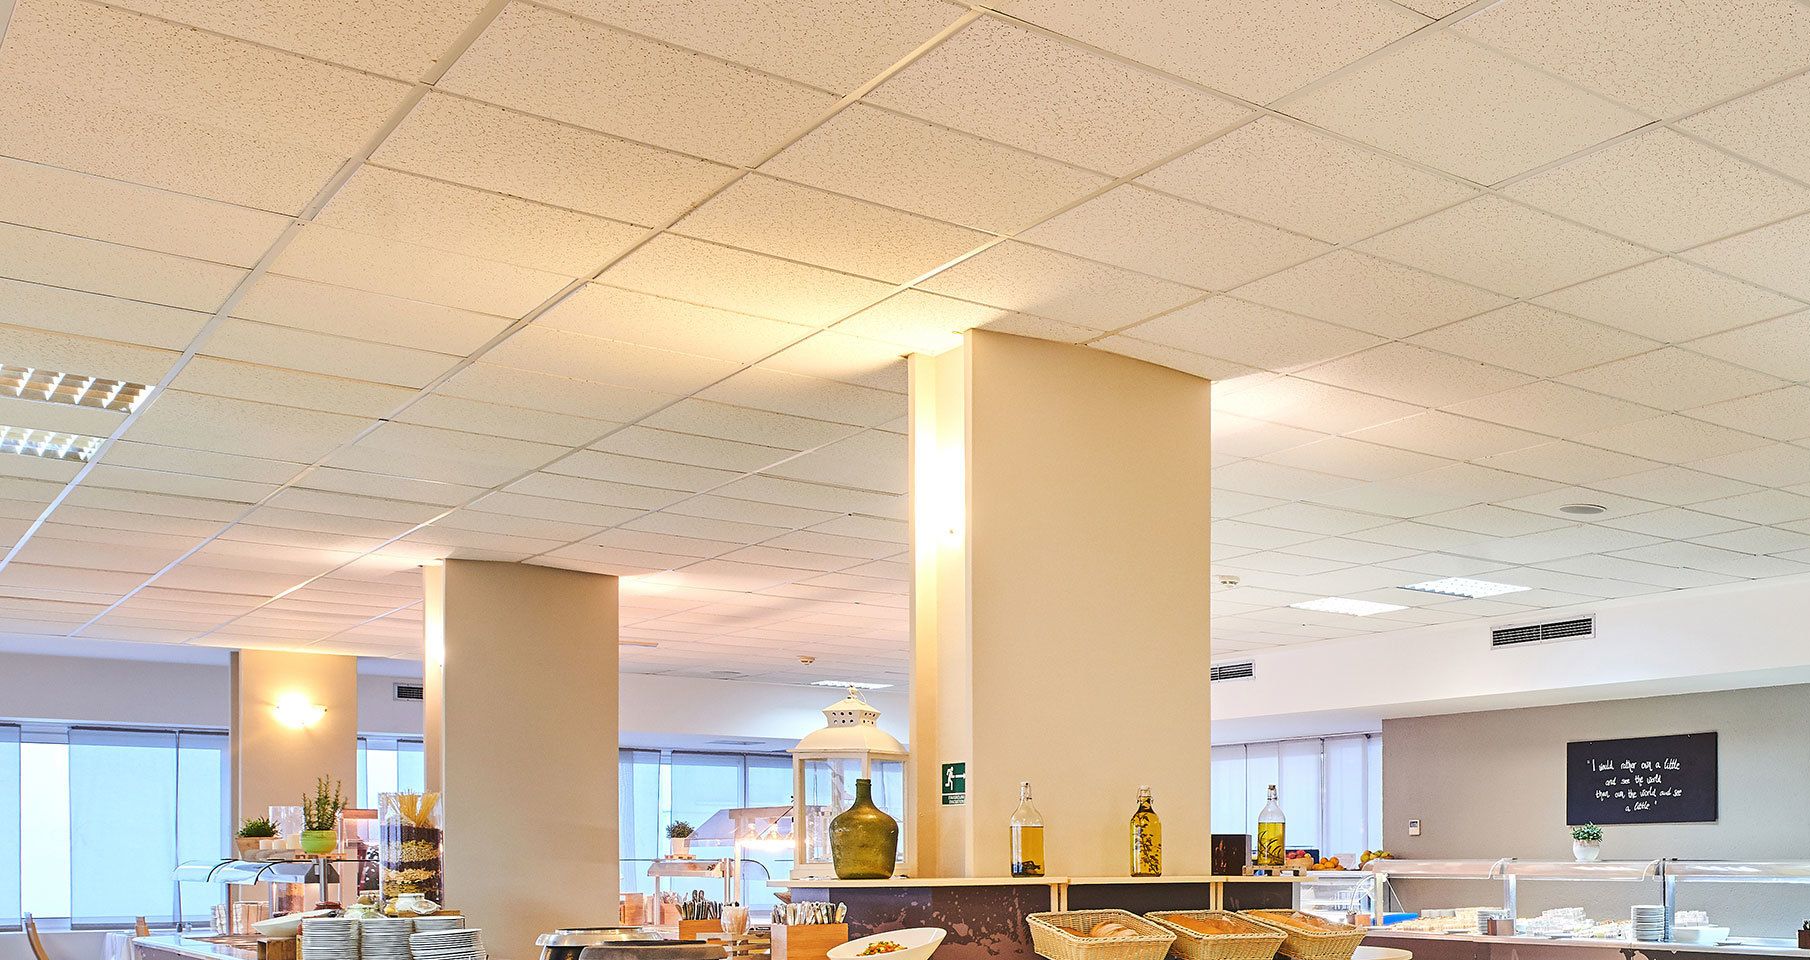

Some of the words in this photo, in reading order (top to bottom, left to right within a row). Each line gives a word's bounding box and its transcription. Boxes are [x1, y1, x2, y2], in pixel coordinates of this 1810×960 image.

[1598, 759, 1614, 771] would
[1620, 759, 1637, 773] rather
[1641, 760, 1653, 772] own
[1664, 758, 1681, 771] little
[1605, 777, 1617, 786] and
[1634, 775, 1644, 787] the
[1646, 774, 1662, 785] world
[1595, 789, 1610, 802] than
[1614, 791, 1625, 799] own
[1627, 788, 1637, 799] the
[1640, 786, 1656, 798] world
[1659, 788, 1672, 797] and
[1672, 789, 1682, 797] see
